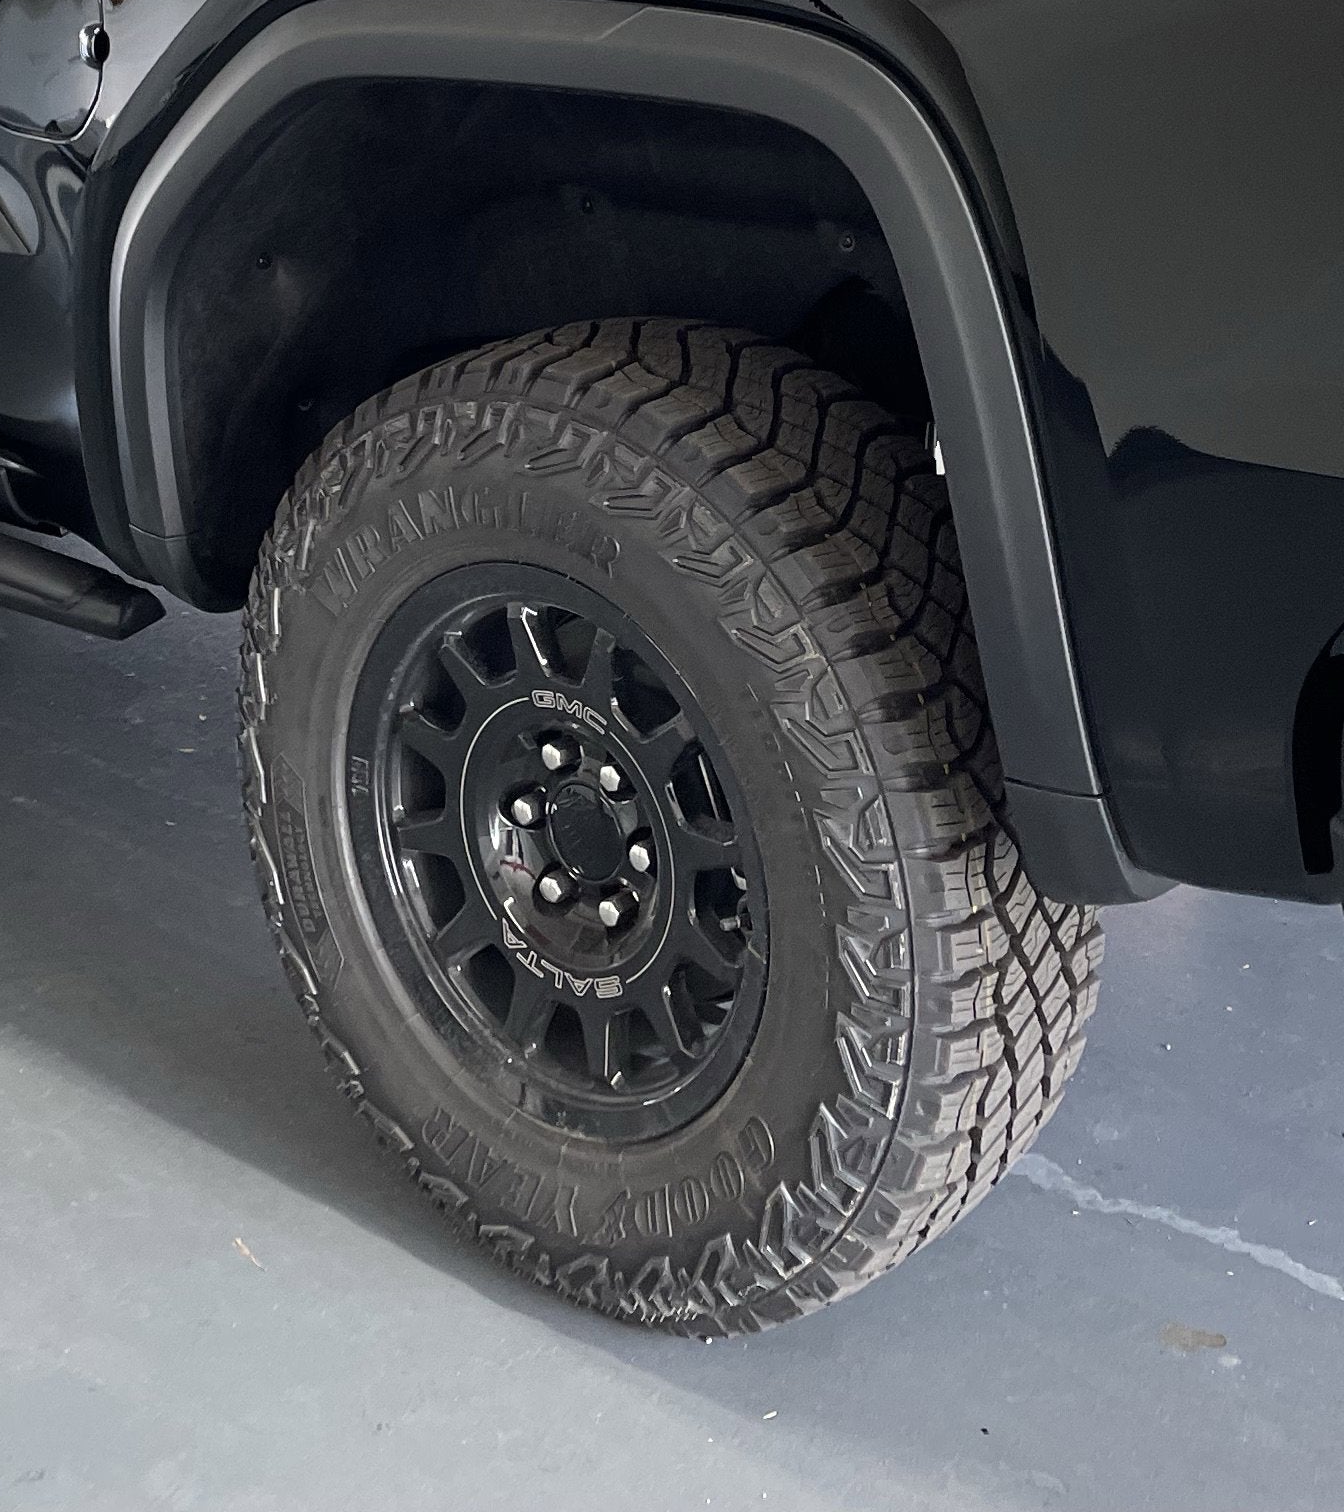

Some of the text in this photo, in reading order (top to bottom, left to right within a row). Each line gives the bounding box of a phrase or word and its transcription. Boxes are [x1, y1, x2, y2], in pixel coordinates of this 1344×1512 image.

[531, 689, 608, 736] GMC
[501, 917, 624, 999] SALTA
[421, 1106, 775, 1246] GOODYEAR
